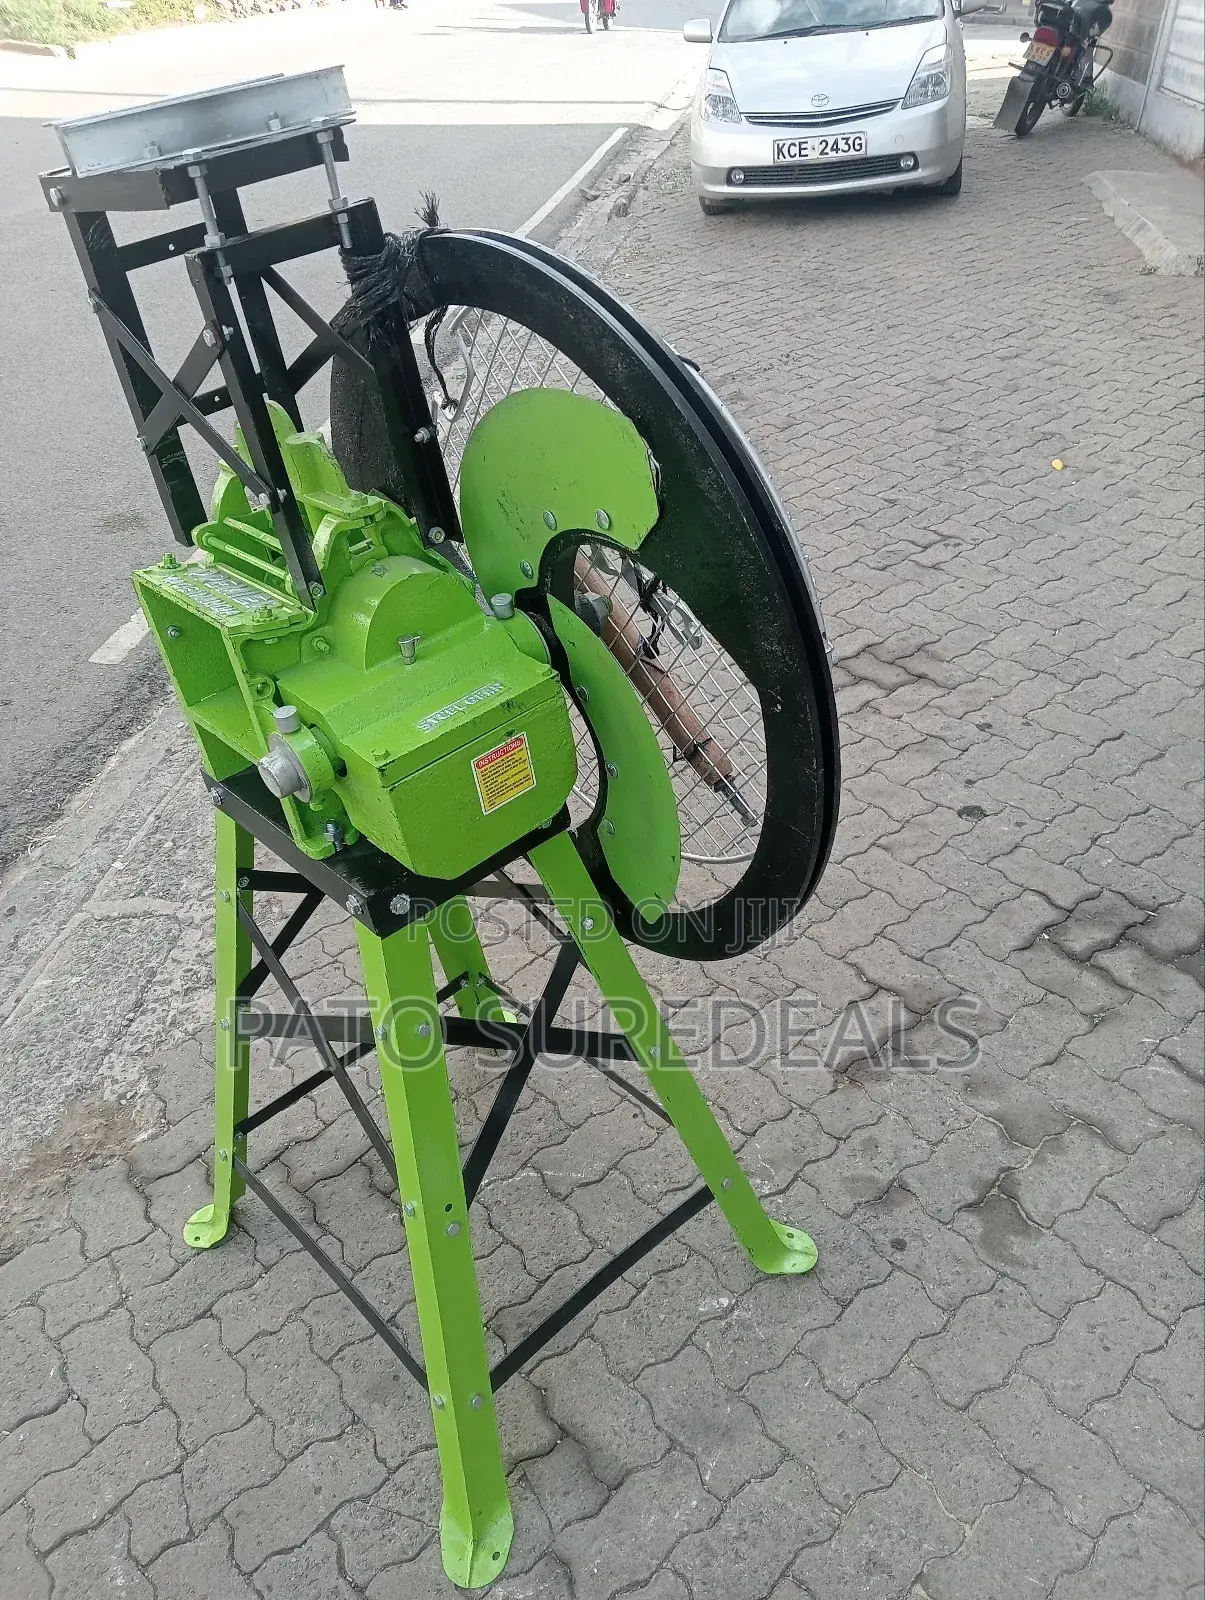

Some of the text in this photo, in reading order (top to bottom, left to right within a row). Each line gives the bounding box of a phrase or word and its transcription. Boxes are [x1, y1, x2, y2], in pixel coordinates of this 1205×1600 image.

[776, 136, 863, 160] KCE 243G
[416, 702, 467, 733] STEEL
